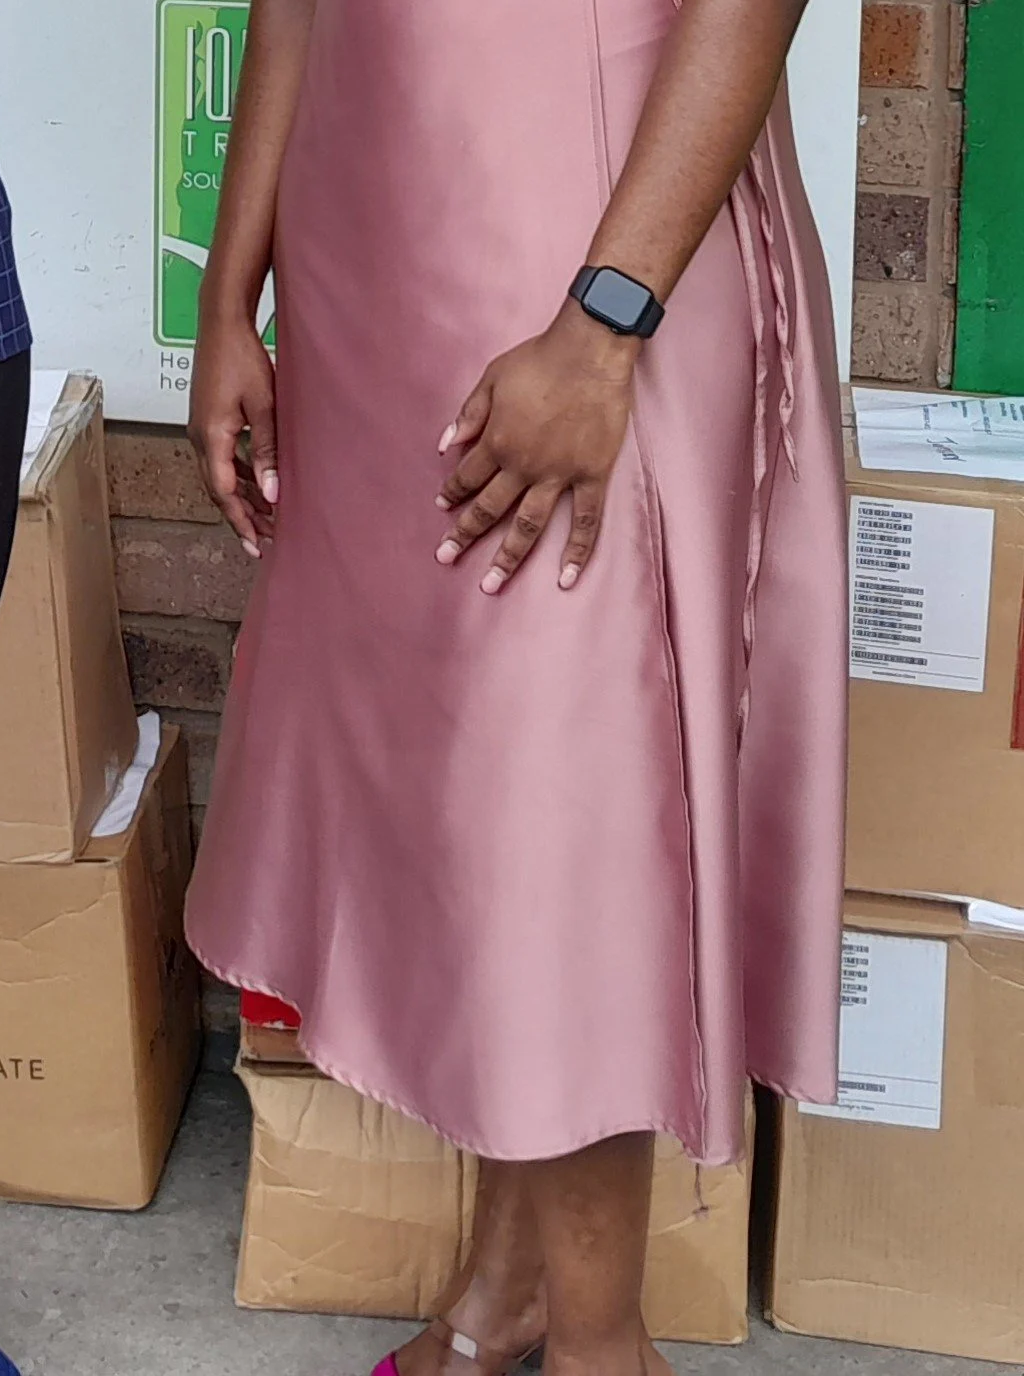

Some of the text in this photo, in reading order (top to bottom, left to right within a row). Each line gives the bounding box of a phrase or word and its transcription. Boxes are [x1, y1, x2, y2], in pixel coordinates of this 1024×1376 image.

[186, 26, 247, 122] IQ
[160, 352, 190, 370] He
[160, 372, 188, 391] he
